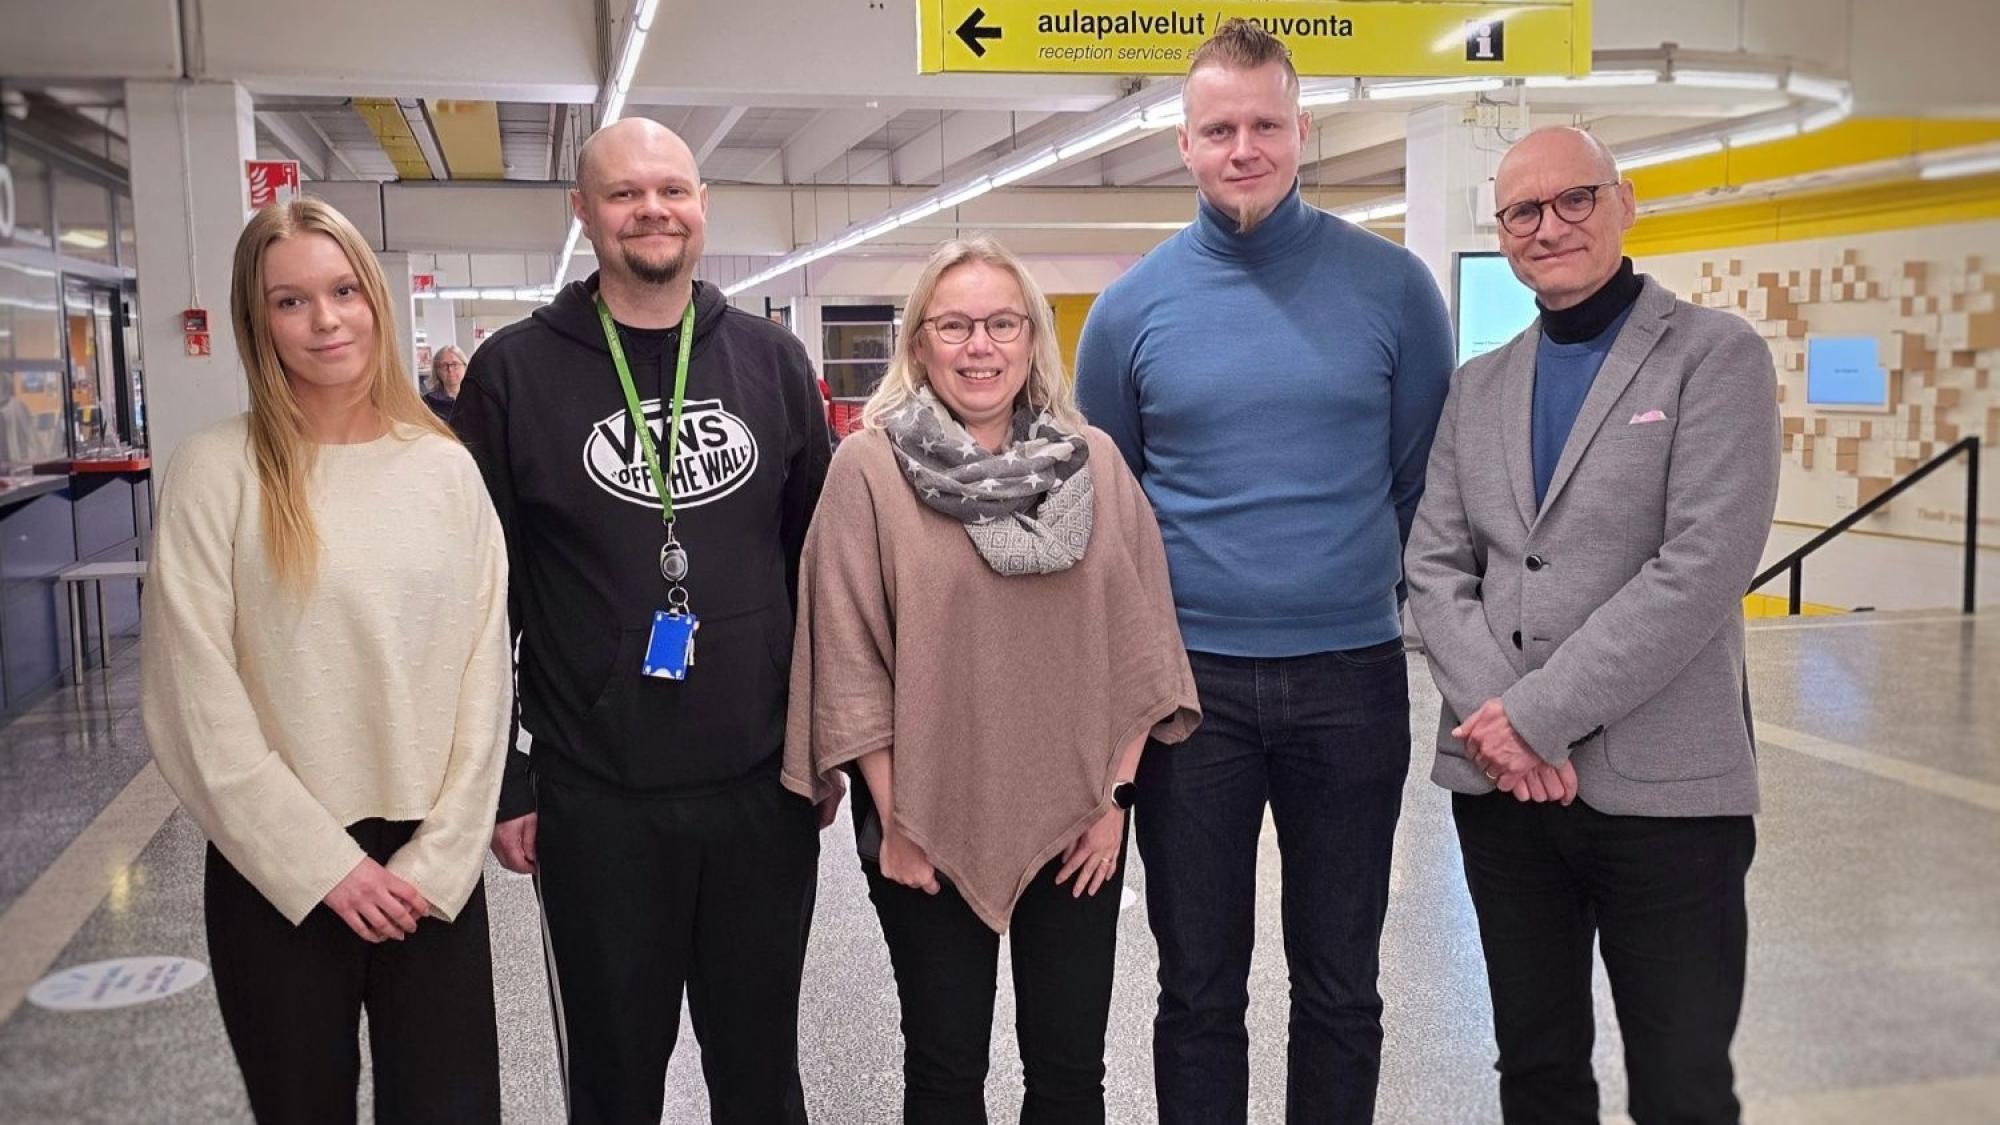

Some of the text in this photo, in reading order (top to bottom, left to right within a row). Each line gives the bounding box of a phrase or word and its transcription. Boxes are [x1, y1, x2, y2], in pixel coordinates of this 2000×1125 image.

[1037, 9, 1206, 41] aulapalvelut
[1038, 45, 1114, 62] reception
[1117, 45, 1183, 60] services
[669, 456, 703, 494] HE
